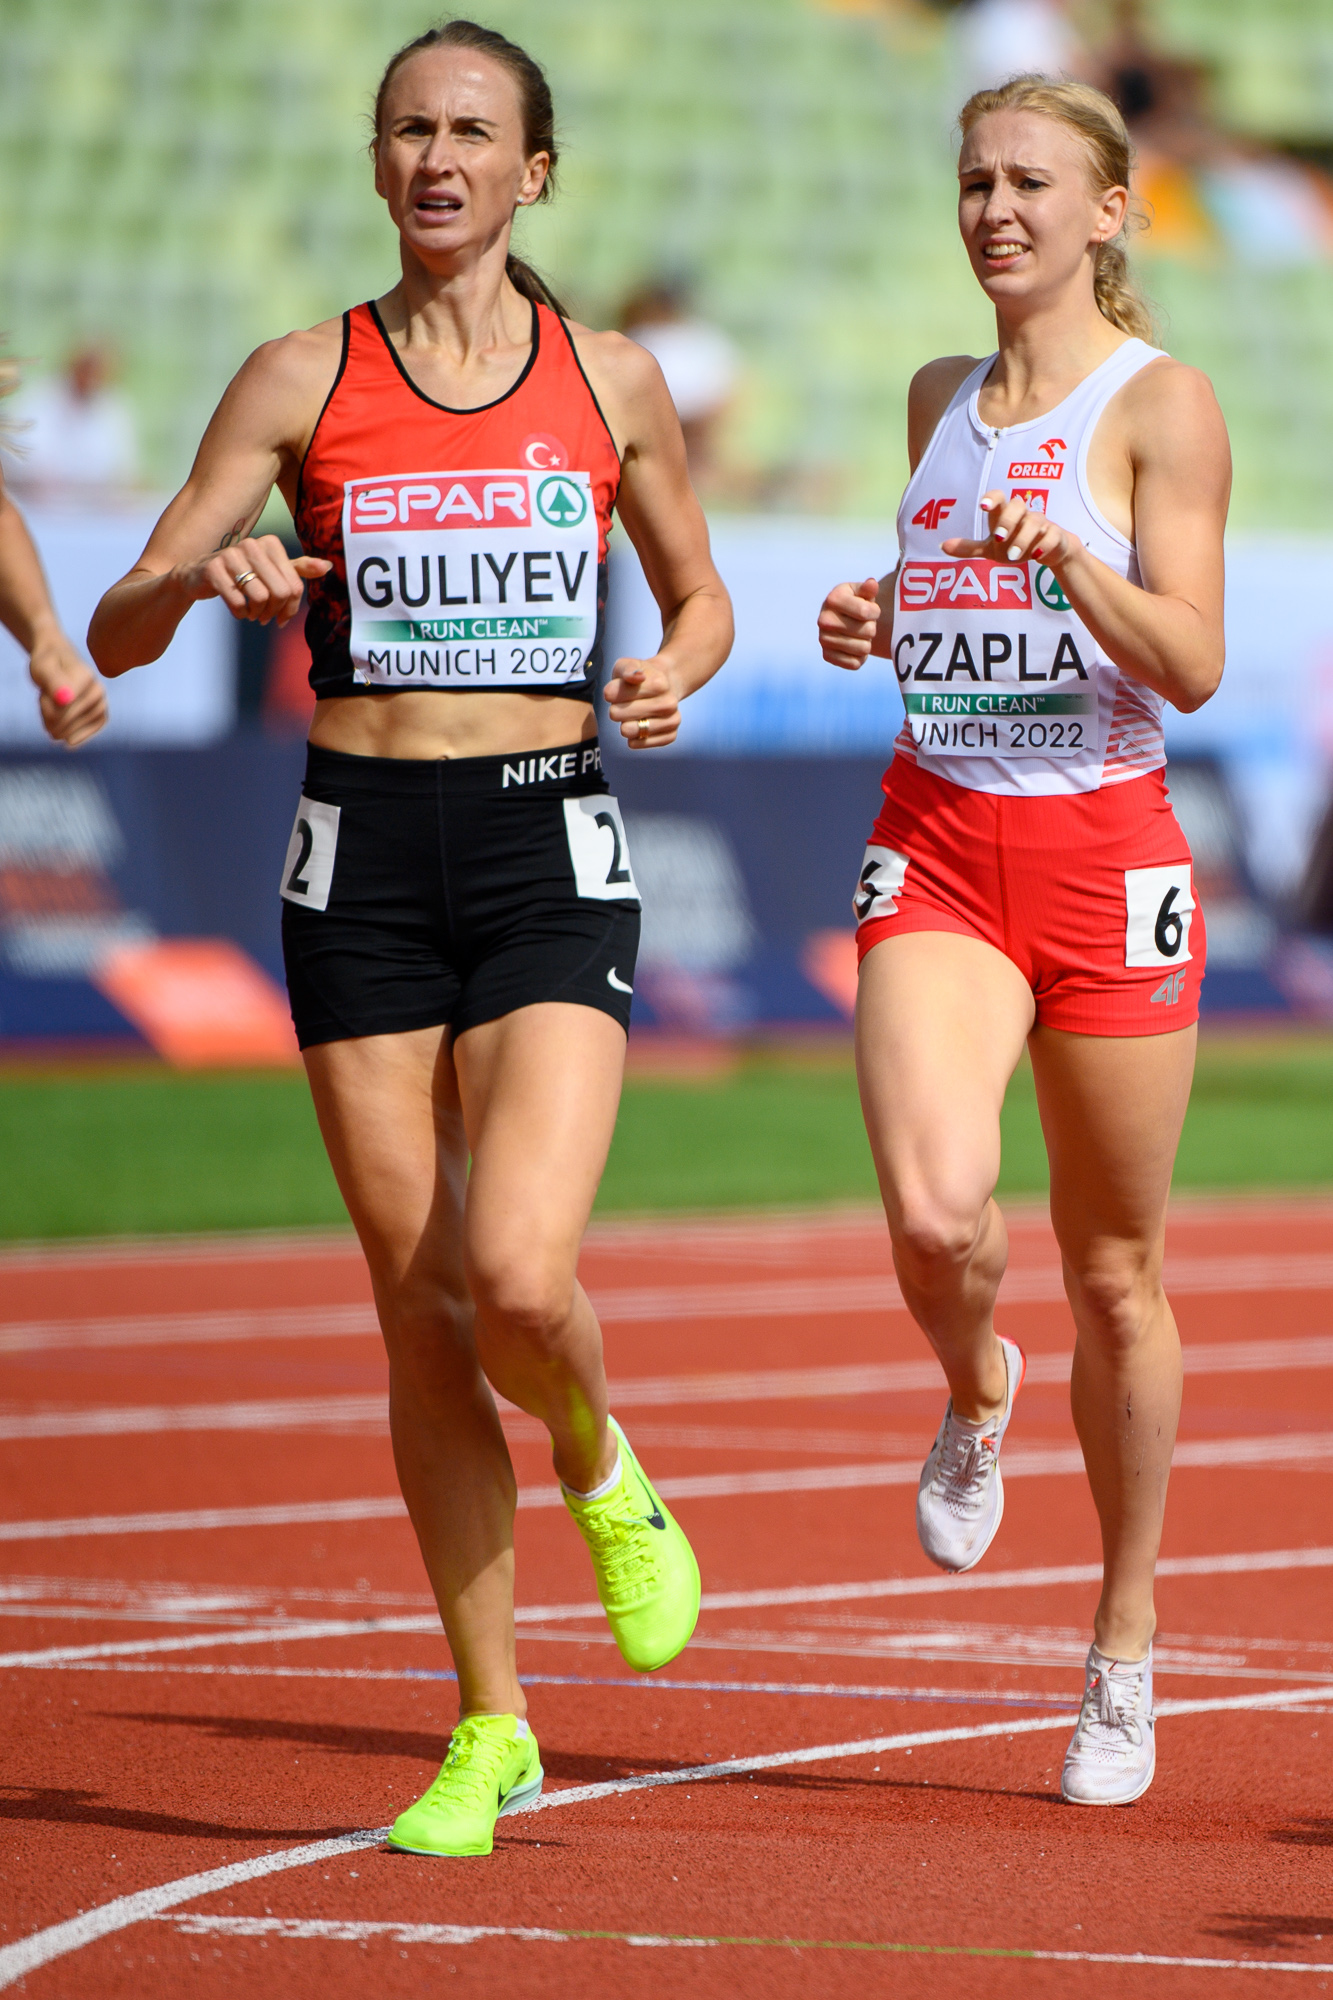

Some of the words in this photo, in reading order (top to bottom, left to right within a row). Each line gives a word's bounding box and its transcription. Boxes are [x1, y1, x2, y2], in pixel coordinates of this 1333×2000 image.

[1011, 464, 1061, 478] ORLEN
[355, 482, 527, 526] SPAR
[911, 498, 957, 530] 4F
[356, 550, 589, 609] GULIYEV
[902, 565, 1028, 605] SPAR
[409, 622, 415, 640] I
[420, 621, 465, 639] RUN
[367, 648, 496, 676] MUNICH
[510, 647, 582, 675] 2022
[894, 632, 1089, 683] CZAPLA
[921, 695, 926, 712] I
[931, 696, 971, 712] RUN
[1010, 722, 1084, 748] 2022
[502, 752, 577, 789] NIKE
[286, 818, 313, 896] 2
[595, 811, 632, 885] 2
[1154, 886, 1181, 958] 6
[1150, 968, 1187, 1007] 4F
